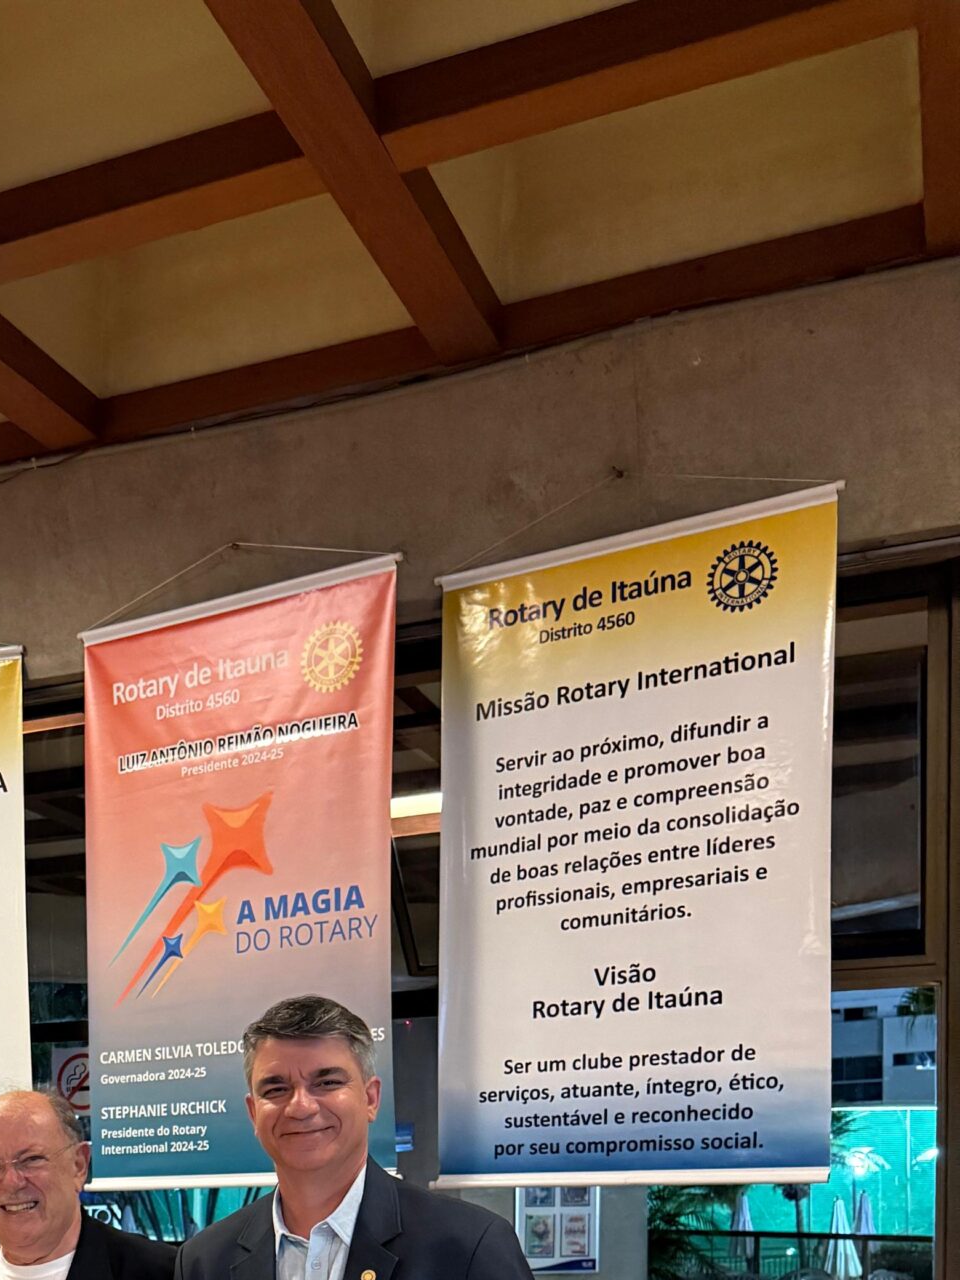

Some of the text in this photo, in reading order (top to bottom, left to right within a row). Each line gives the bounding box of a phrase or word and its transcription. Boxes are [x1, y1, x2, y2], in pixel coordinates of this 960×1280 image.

[488, 568, 692, 630] Rotary de Itaúna
[538, 611, 635, 645] Distrito 4560
[112, 673, 179, 705] Rotary
[184, 663, 212, 688] de
[475, 641, 795, 722] Missão Rotary International
[156, 689, 240, 720] Distrito 4560
[119, 753, 146, 772] LUIZ
[151, 740, 214, 767] ANTÔNIO
[495, 714, 769, 773] Servir ao próximo, difundir a
[181, 748, 284, 777] Presidente 2024-25
[498, 744, 765, 801] integridade e promover boa
[495, 773, 769, 829] vontade, paz e compreensão
[470, 799, 800, 861] mundial por meio da consolidação
[490, 832, 776, 885] de boas relações entre líderes
[236, 885, 365, 925] A MAGIA
[496, 863, 768, 914] profissionais, empresariais e
[235, 914, 378, 954] DO ROTARY
[560, 904, 692, 931] comunitários.
[594, 964, 657, 987] Visão
[532, 987, 724, 1020] Rotary de Itaúna
[99, 1049, 152, 1065] CARMEN
[155, 1045, 193, 1061] SILVIA
[503, 1043, 757, 1075] Ser um clube prestador de
[100, 1067, 207, 1085] Governadora 2024-25
[478, 1072, 785, 1106] serviços, atuante, íntegro, ético,
[100, 1099, 227, 1120] STEPHANIE URCHICK
[504, 1103, 754, 1129] sustentável e reconhecido
[101, 1123, 207, 1140] Presidente do Rotary
[101, 1140, 210, 1156] International 2024-25
[494, 1131, 764, 1160] por seu compromisso social.
